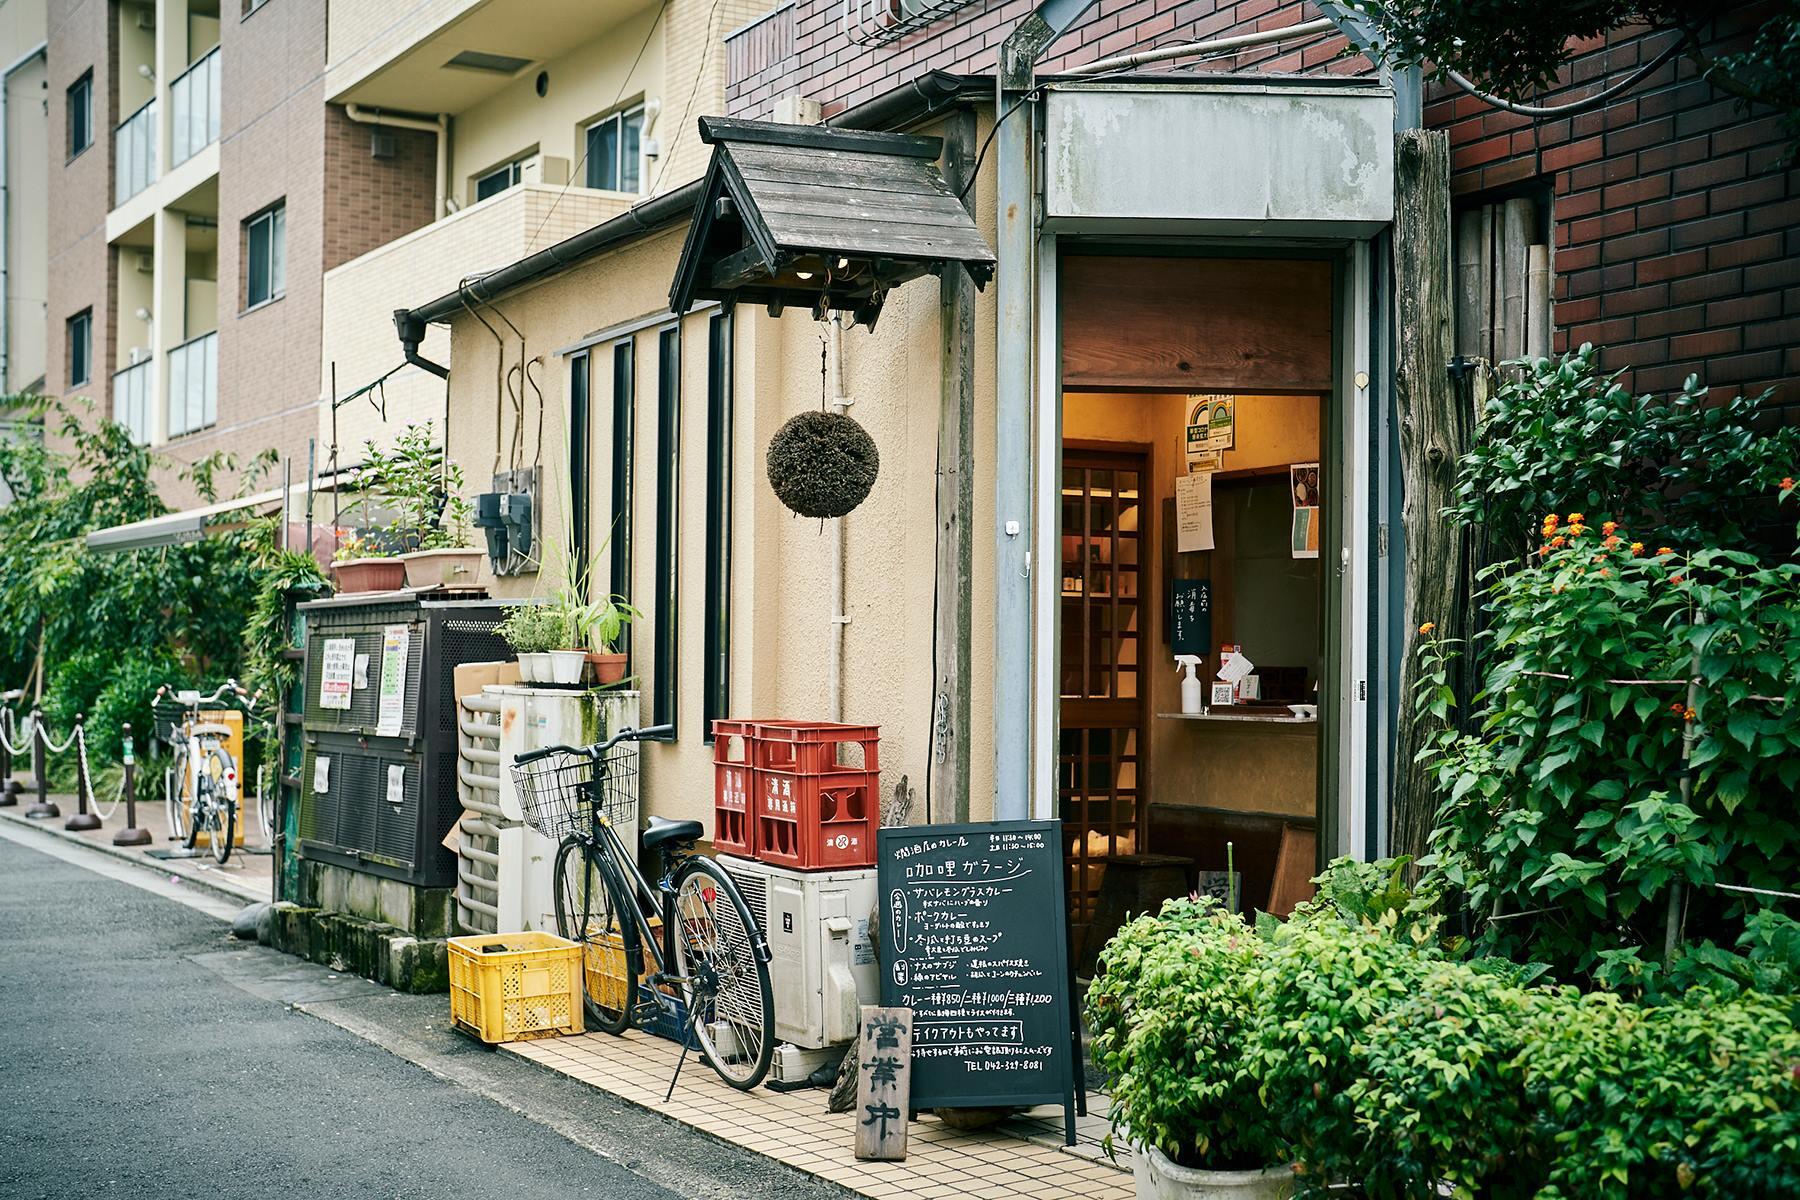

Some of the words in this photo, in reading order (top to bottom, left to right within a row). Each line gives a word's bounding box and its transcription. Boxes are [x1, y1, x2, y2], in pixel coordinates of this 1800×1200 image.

[912, 886, 1013, 899] サバレモングラスカレー
[914, 911, 968, 924] ポークカレー
[964, 1060, 983, 1072] TEL
[984, 1059, 1043, 1071] 042-329-8081
[862, 1014, 907, 1141] 営業中
